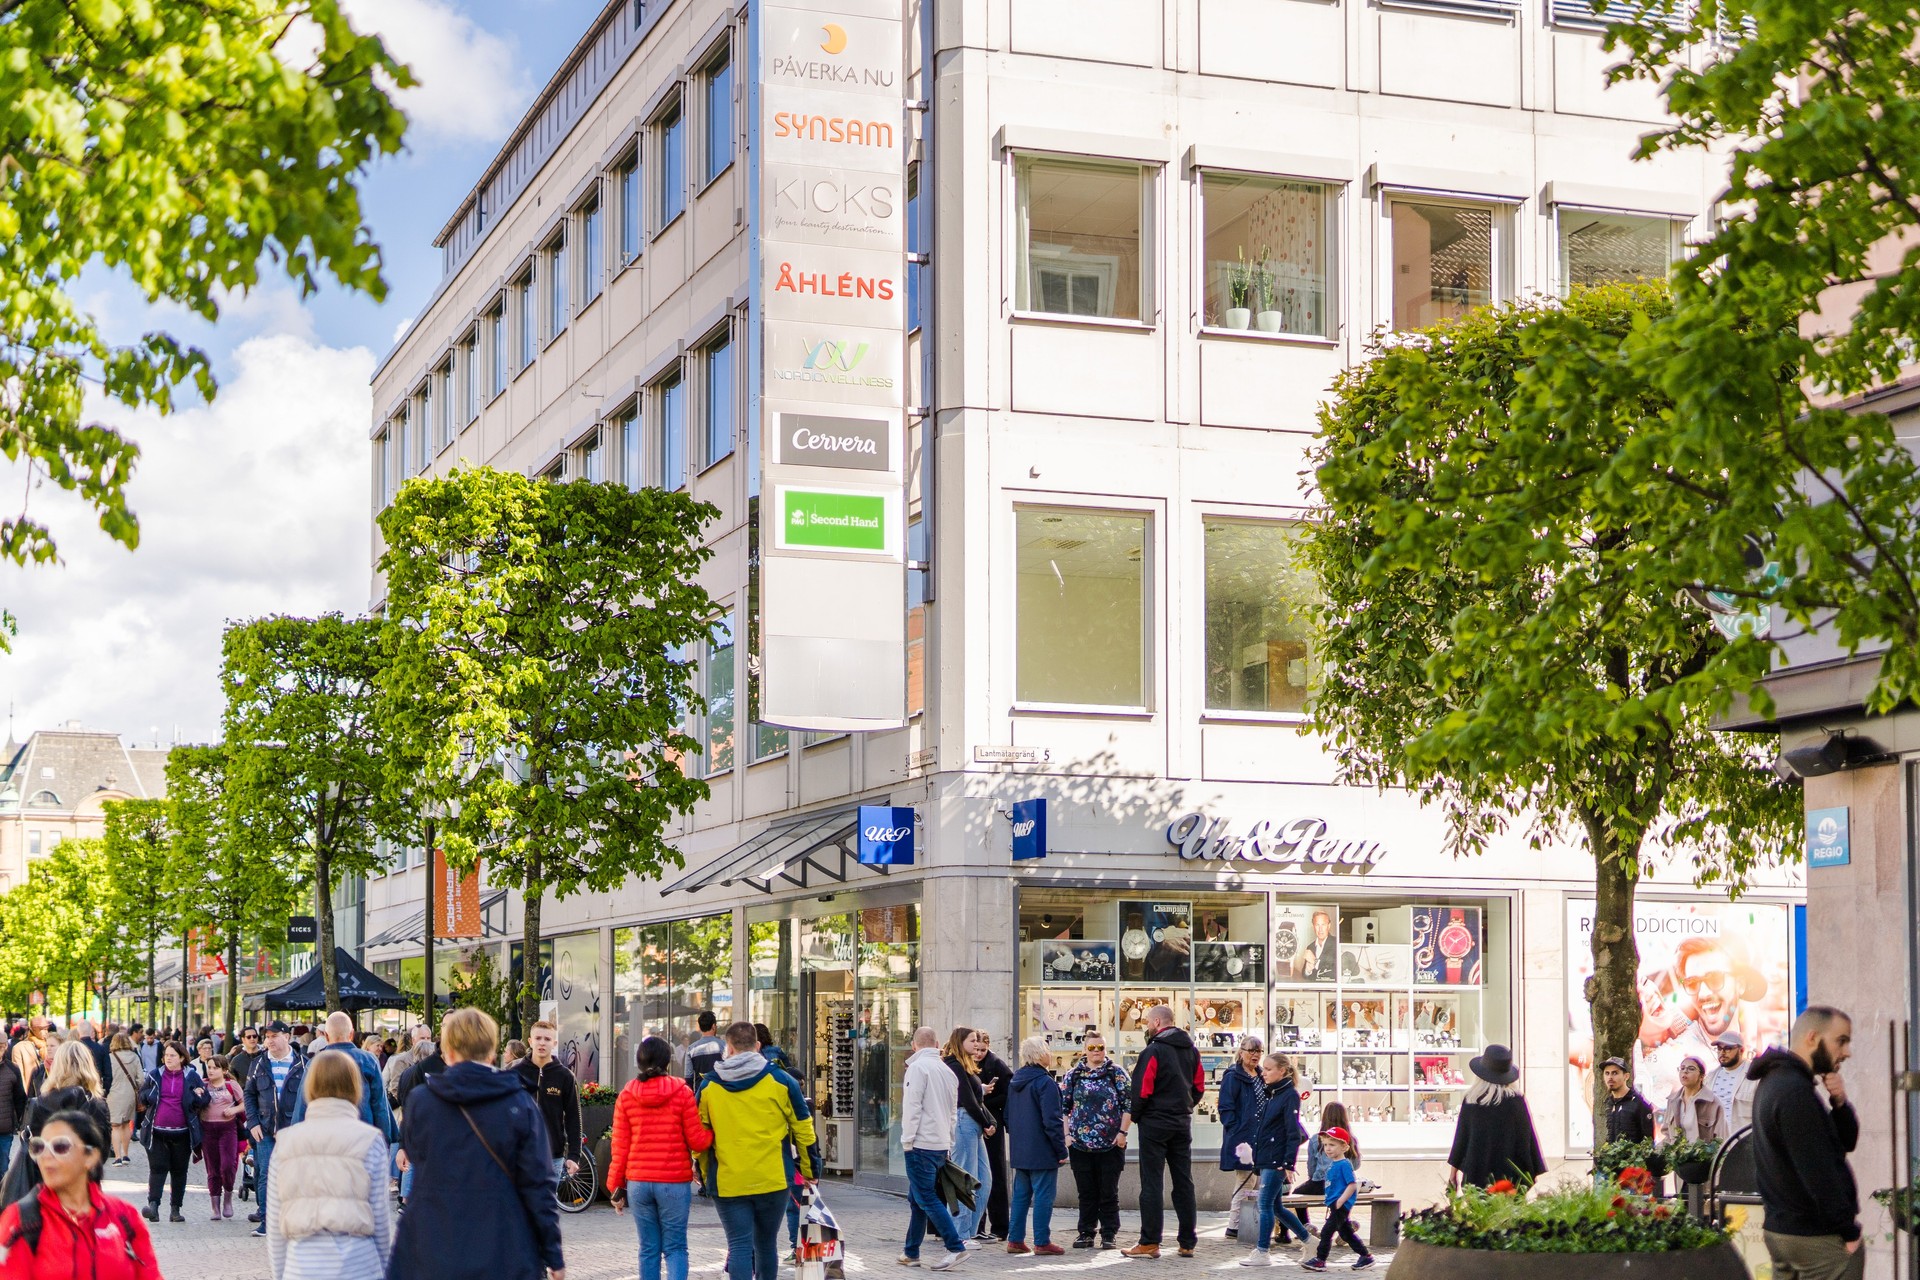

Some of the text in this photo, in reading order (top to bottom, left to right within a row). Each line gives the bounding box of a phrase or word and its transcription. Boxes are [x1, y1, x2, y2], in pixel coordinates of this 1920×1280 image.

[773, 56, 894, 87] PÅVERKA NU
[774, 111, 893, 148] SYNSAM
[774, 177, 893, 219] KICKS
[774, 215, 798, 229] Your
[800, 217, 830, 235] beauty
[774, 262, 894, 301] ÅHLÉNS
[791, 427, 877, 455] Cervera
[810, 512, 849, 526] Second
[850, 516, 879, 528] Hand
[1044, 749, 1051, 762] 5
[864, 825, 911, 842] U&P
[1813, 846, 1844, 859] REGIO
[1636, 917, 1717, 934] DDICTION
